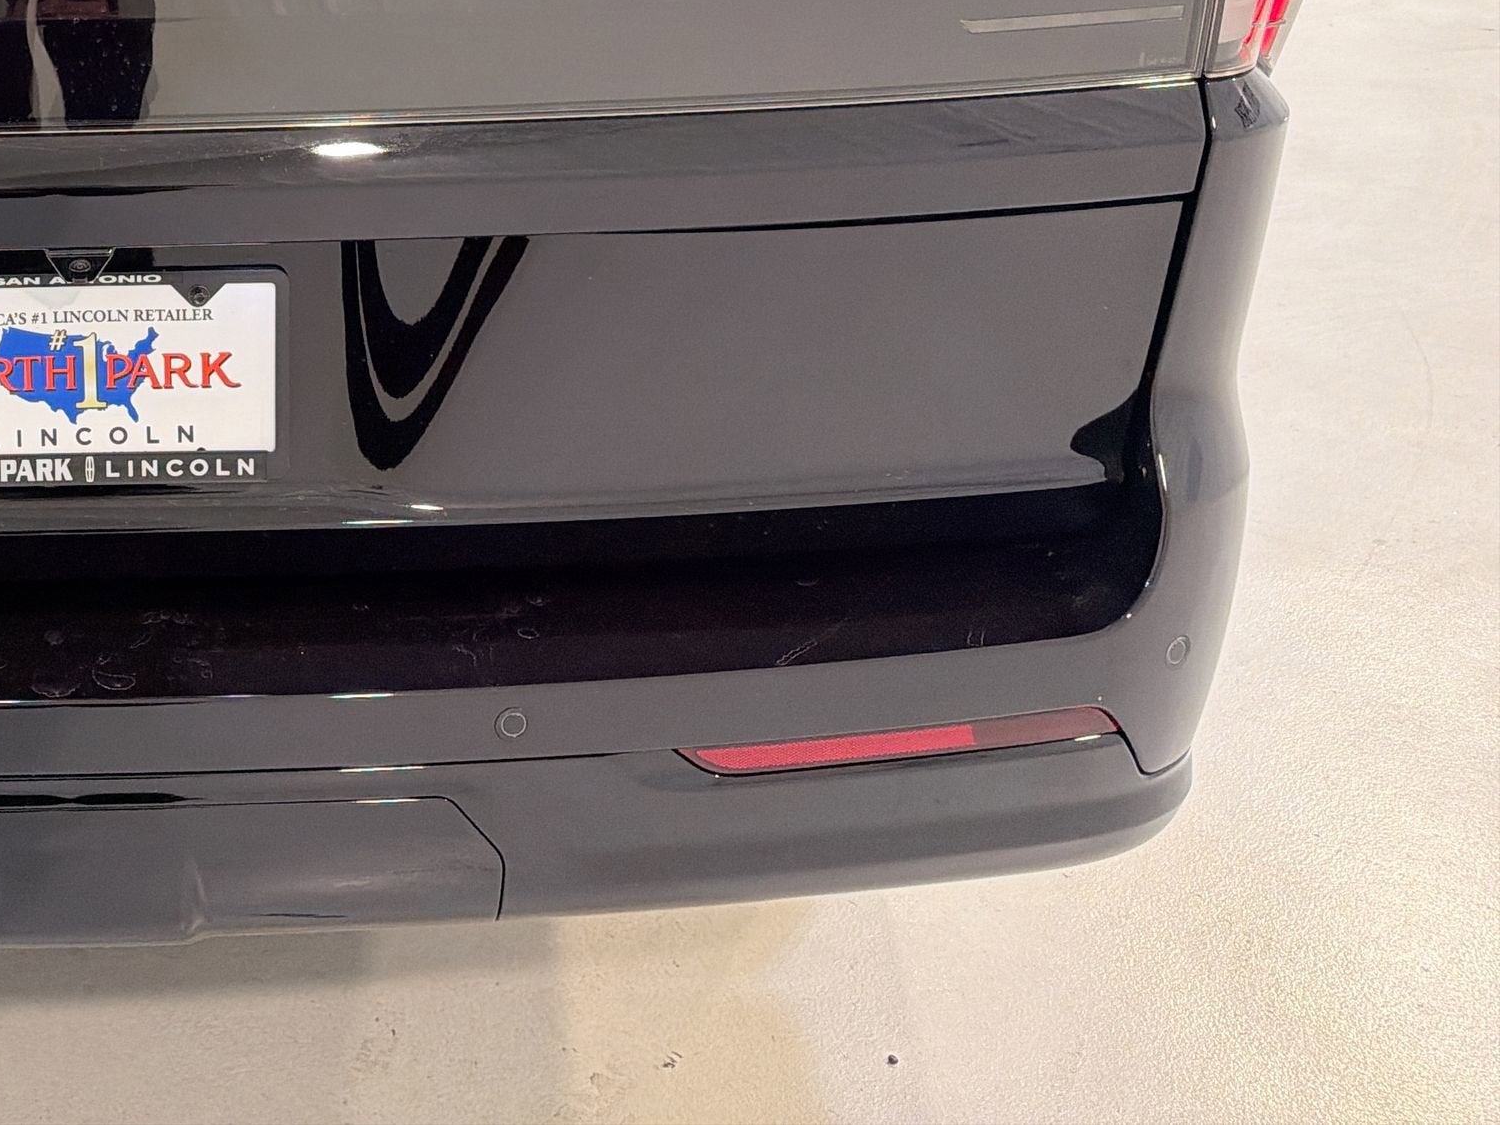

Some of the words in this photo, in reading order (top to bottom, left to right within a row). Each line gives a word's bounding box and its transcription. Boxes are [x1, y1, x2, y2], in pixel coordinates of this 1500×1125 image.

[49, 274, 162, 285] AONIO
[31, 311, 47, 325] #1
[53, 309, 129, 324] LINCOLN
[133, 308, 214, 322] RETAILER
[105, 351, 242, 389] PARK
[0, 458, 74, 482] PARK
[106, 457, 255, 477] LINCOLN
